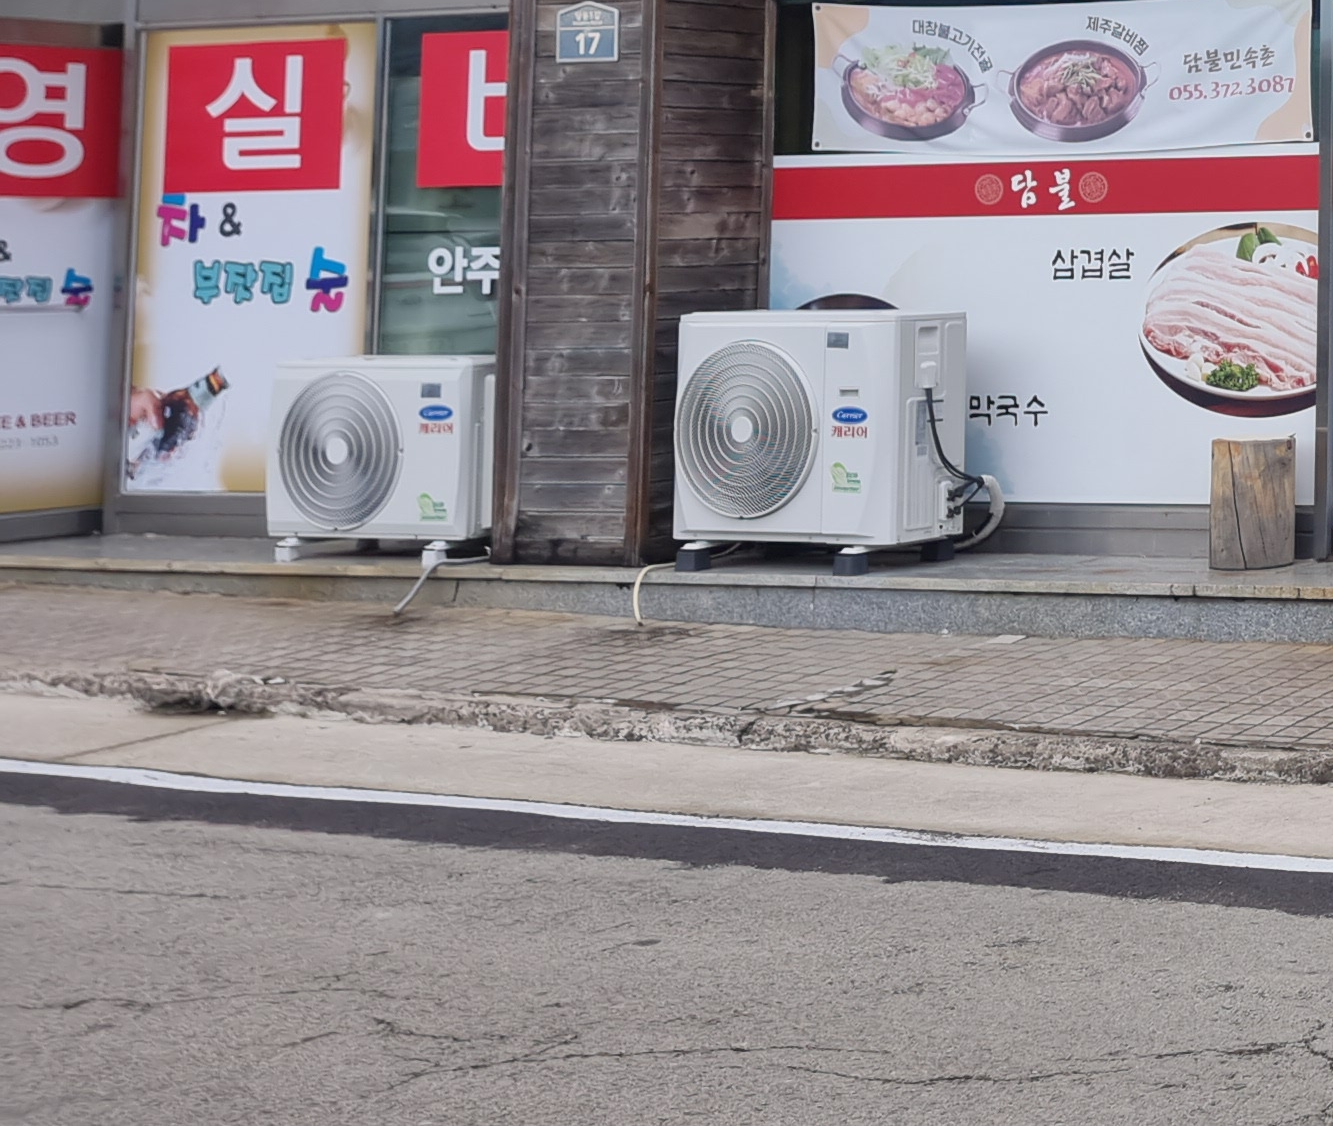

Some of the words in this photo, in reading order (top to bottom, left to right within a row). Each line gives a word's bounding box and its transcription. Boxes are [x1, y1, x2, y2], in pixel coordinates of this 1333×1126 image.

[575, 33, 600, 54] 17
[912, 19, 994, 74] 대창불고기전골
[1085, 15, 1149, 57] 제주갈비찜
[1183, 44, 1275, 73] 담불민속촌
[1168, 74, 1295, 100] 055.372.3087
[0, 57, 87, 178] 영
[205, 55, 304, 170] 실
[1011, 168, 1076, 210] 담불
[219, 203, 242, 237] &
[1051, 248, 1135, 281] 삼겹살
[30, 411, 76, 429] BEER
[968, 394, 1049, 428] 막국수
[831, 425, 868, 439] 캐리어
